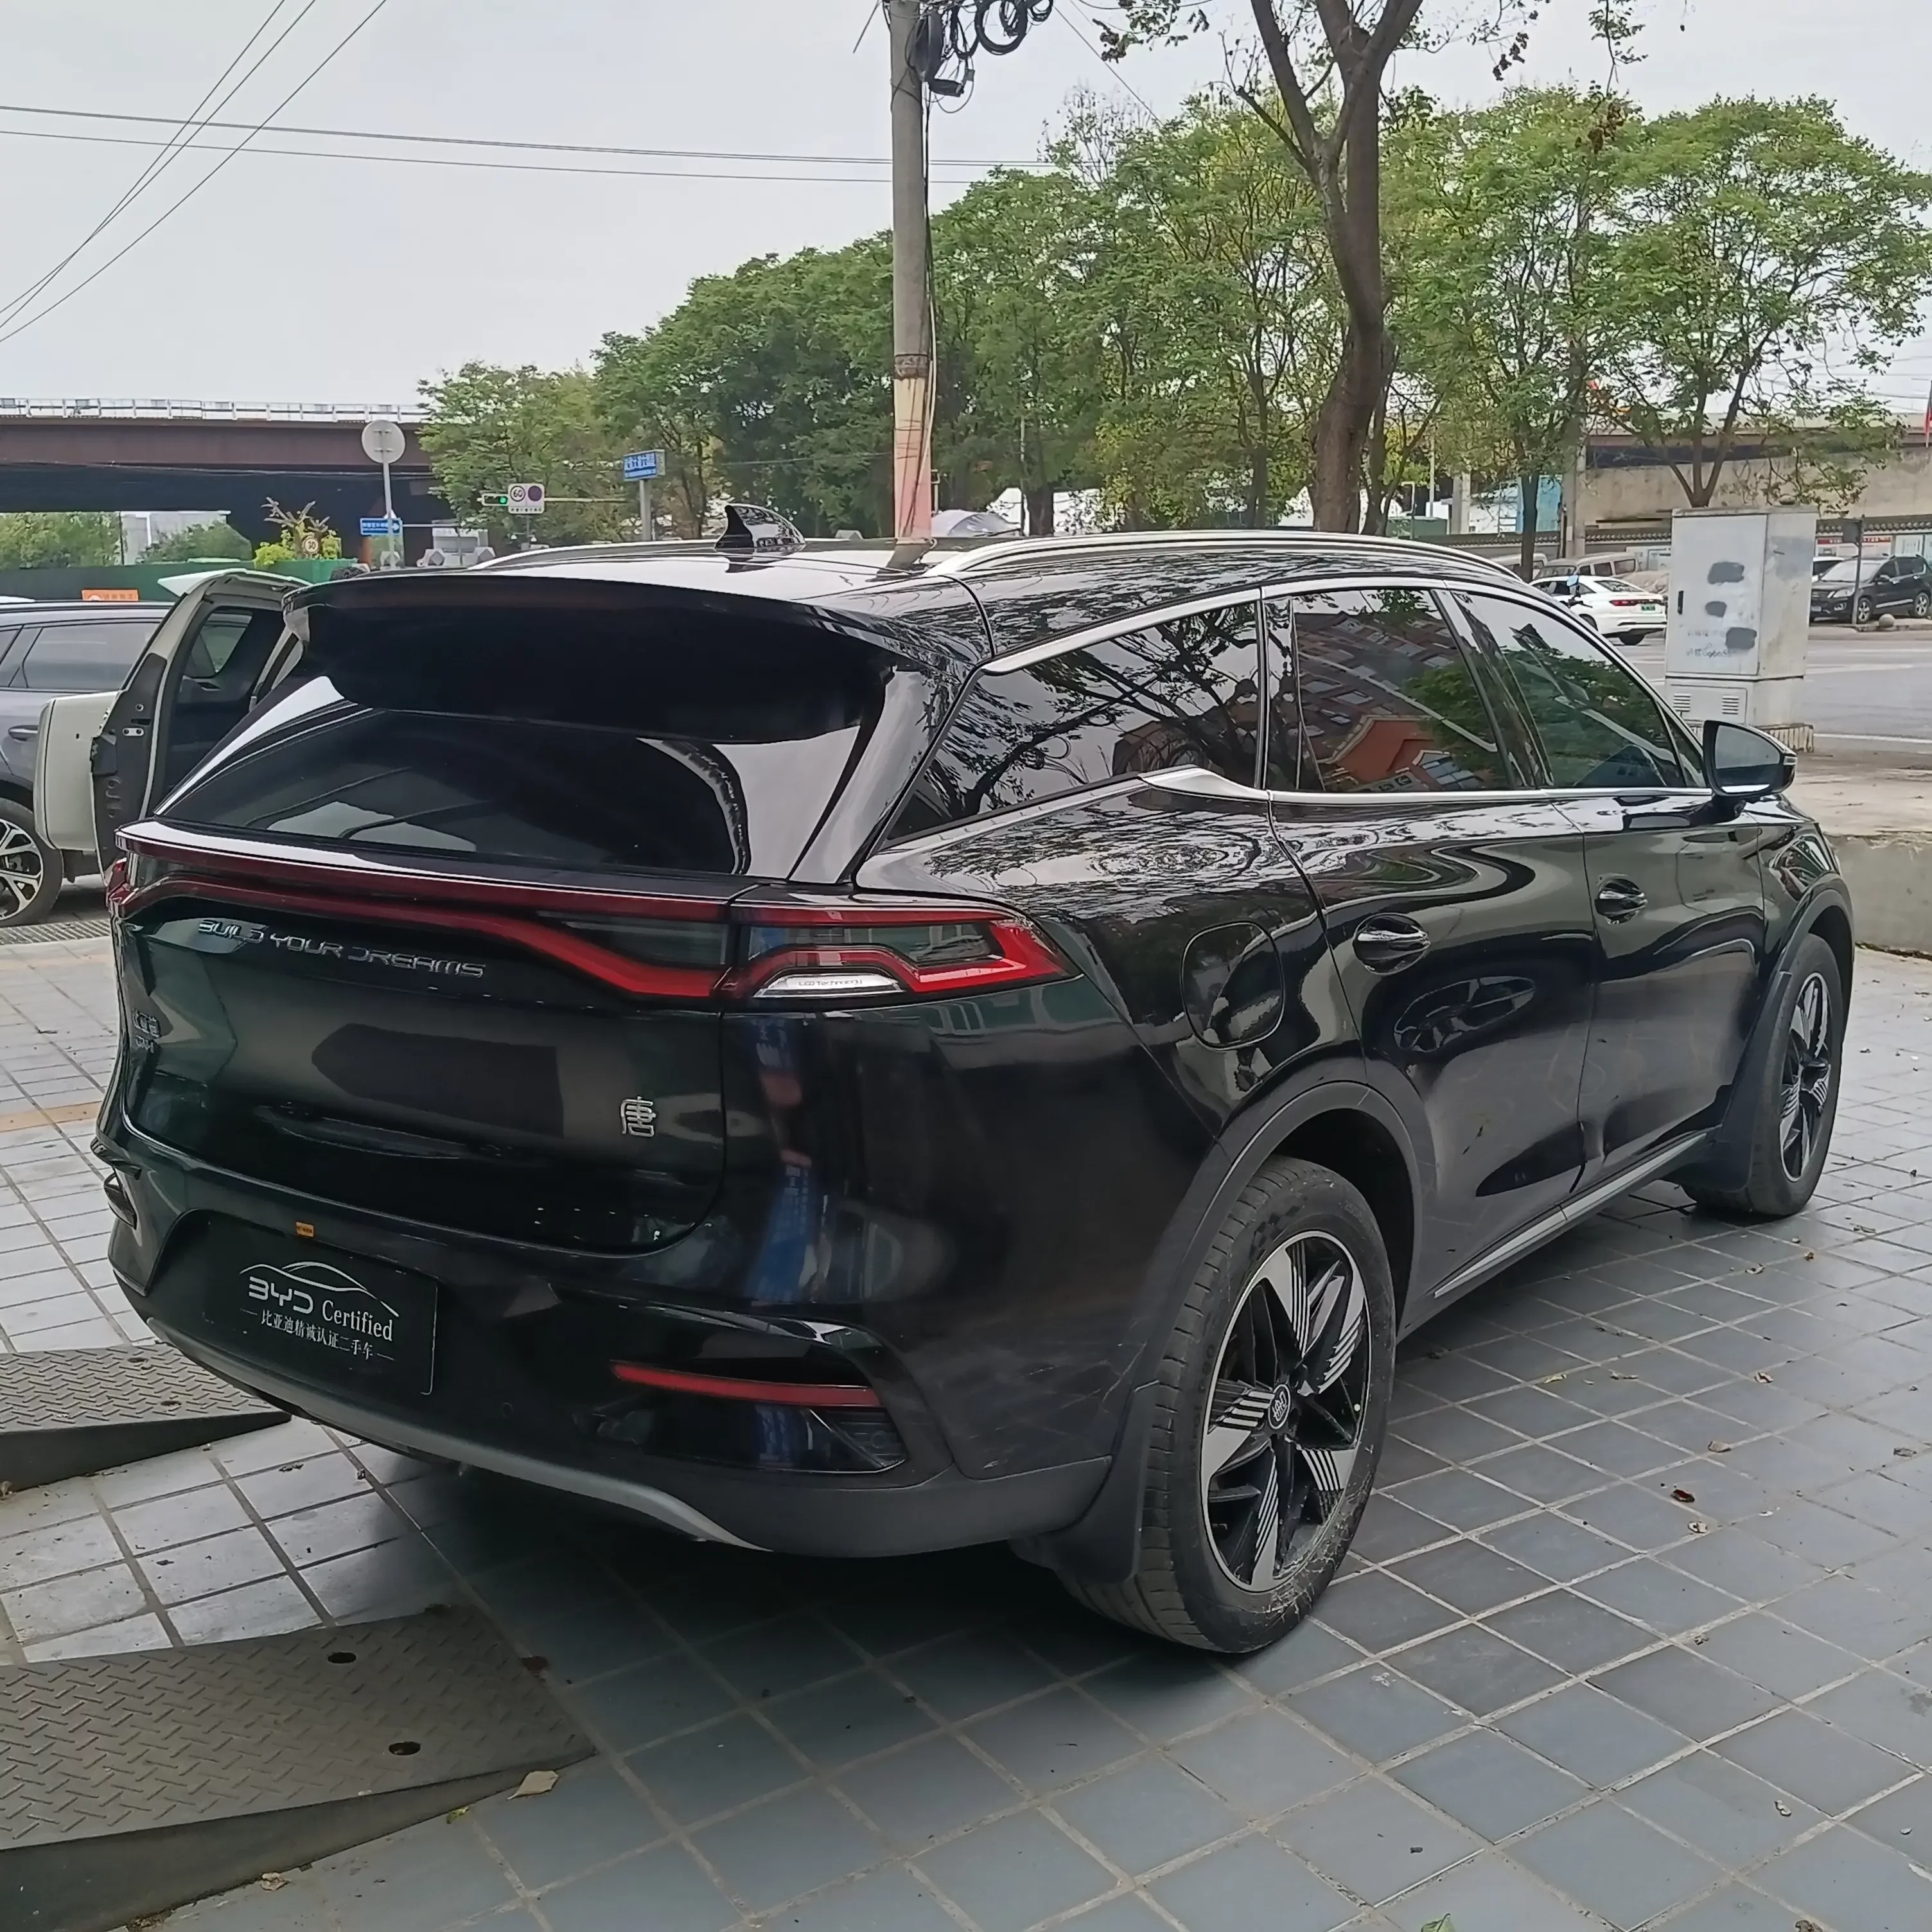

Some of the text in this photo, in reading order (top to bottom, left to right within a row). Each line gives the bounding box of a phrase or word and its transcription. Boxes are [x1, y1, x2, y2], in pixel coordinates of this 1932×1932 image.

[270, 933, 343, 958] YOUR
[348, 947, 486, 978] DREAMS
[620, 1096, 656, 1137] 唐
[249, 1276, 393, 1341] BYD Certified
